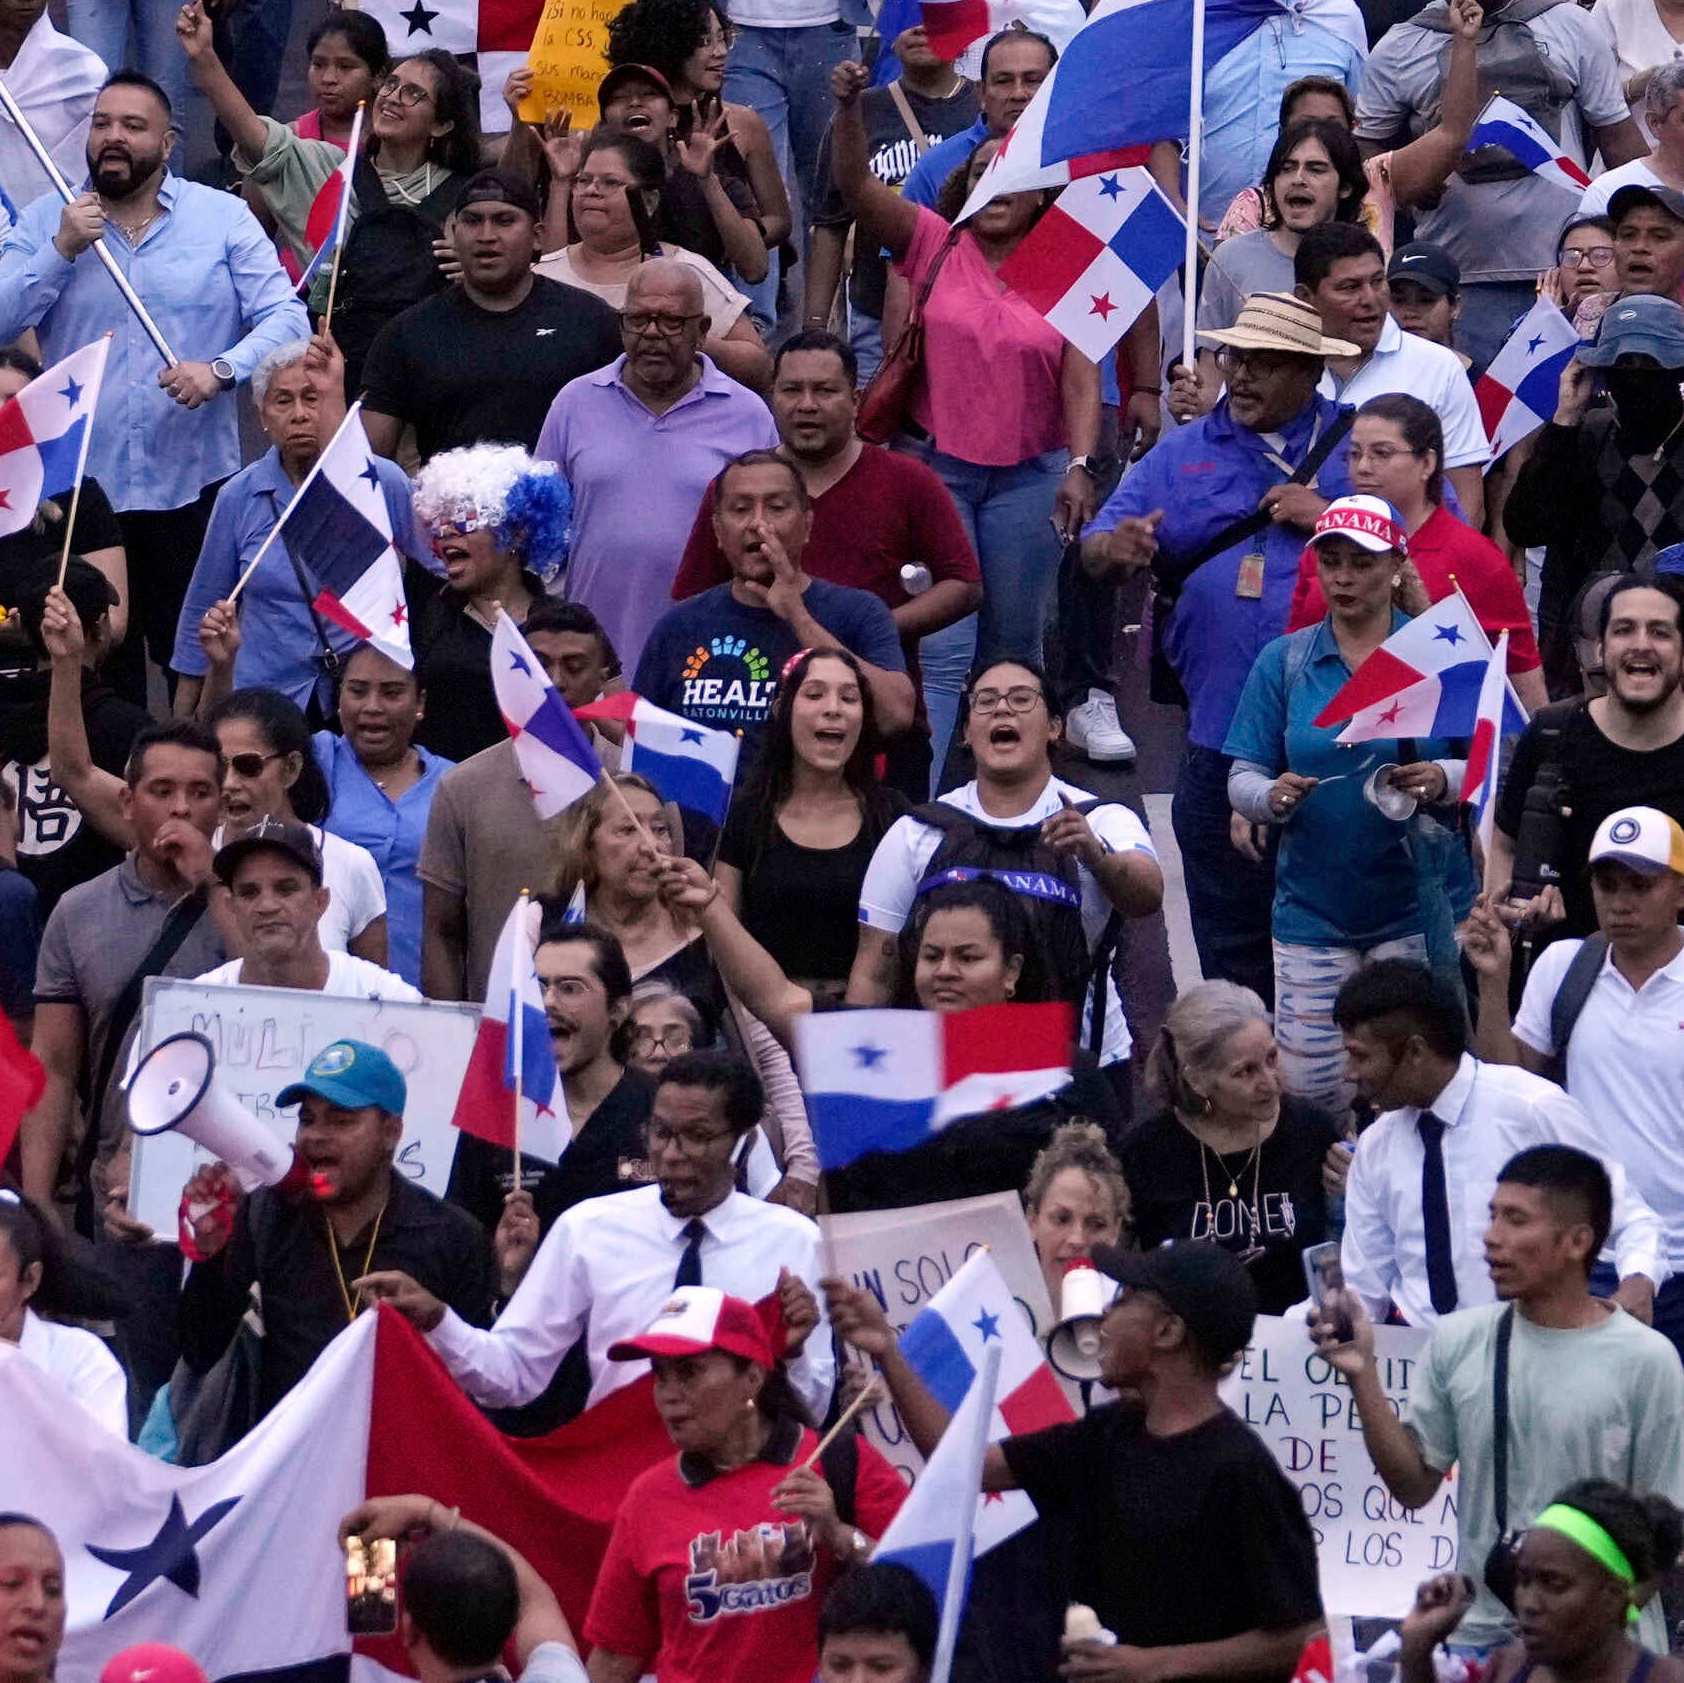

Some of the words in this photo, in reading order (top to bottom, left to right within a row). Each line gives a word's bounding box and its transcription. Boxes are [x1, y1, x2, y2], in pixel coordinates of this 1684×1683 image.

[543, 25, 555, 47] la
[1245, 1392, 1291, 1426] LA
[1281, 1437, 1336, 1473] DE
[1307, 1482, 1344, 1519] OS
[1345, 1530, 1404, 1568] LOS
[1428, 1534, 1458, 1571] D
